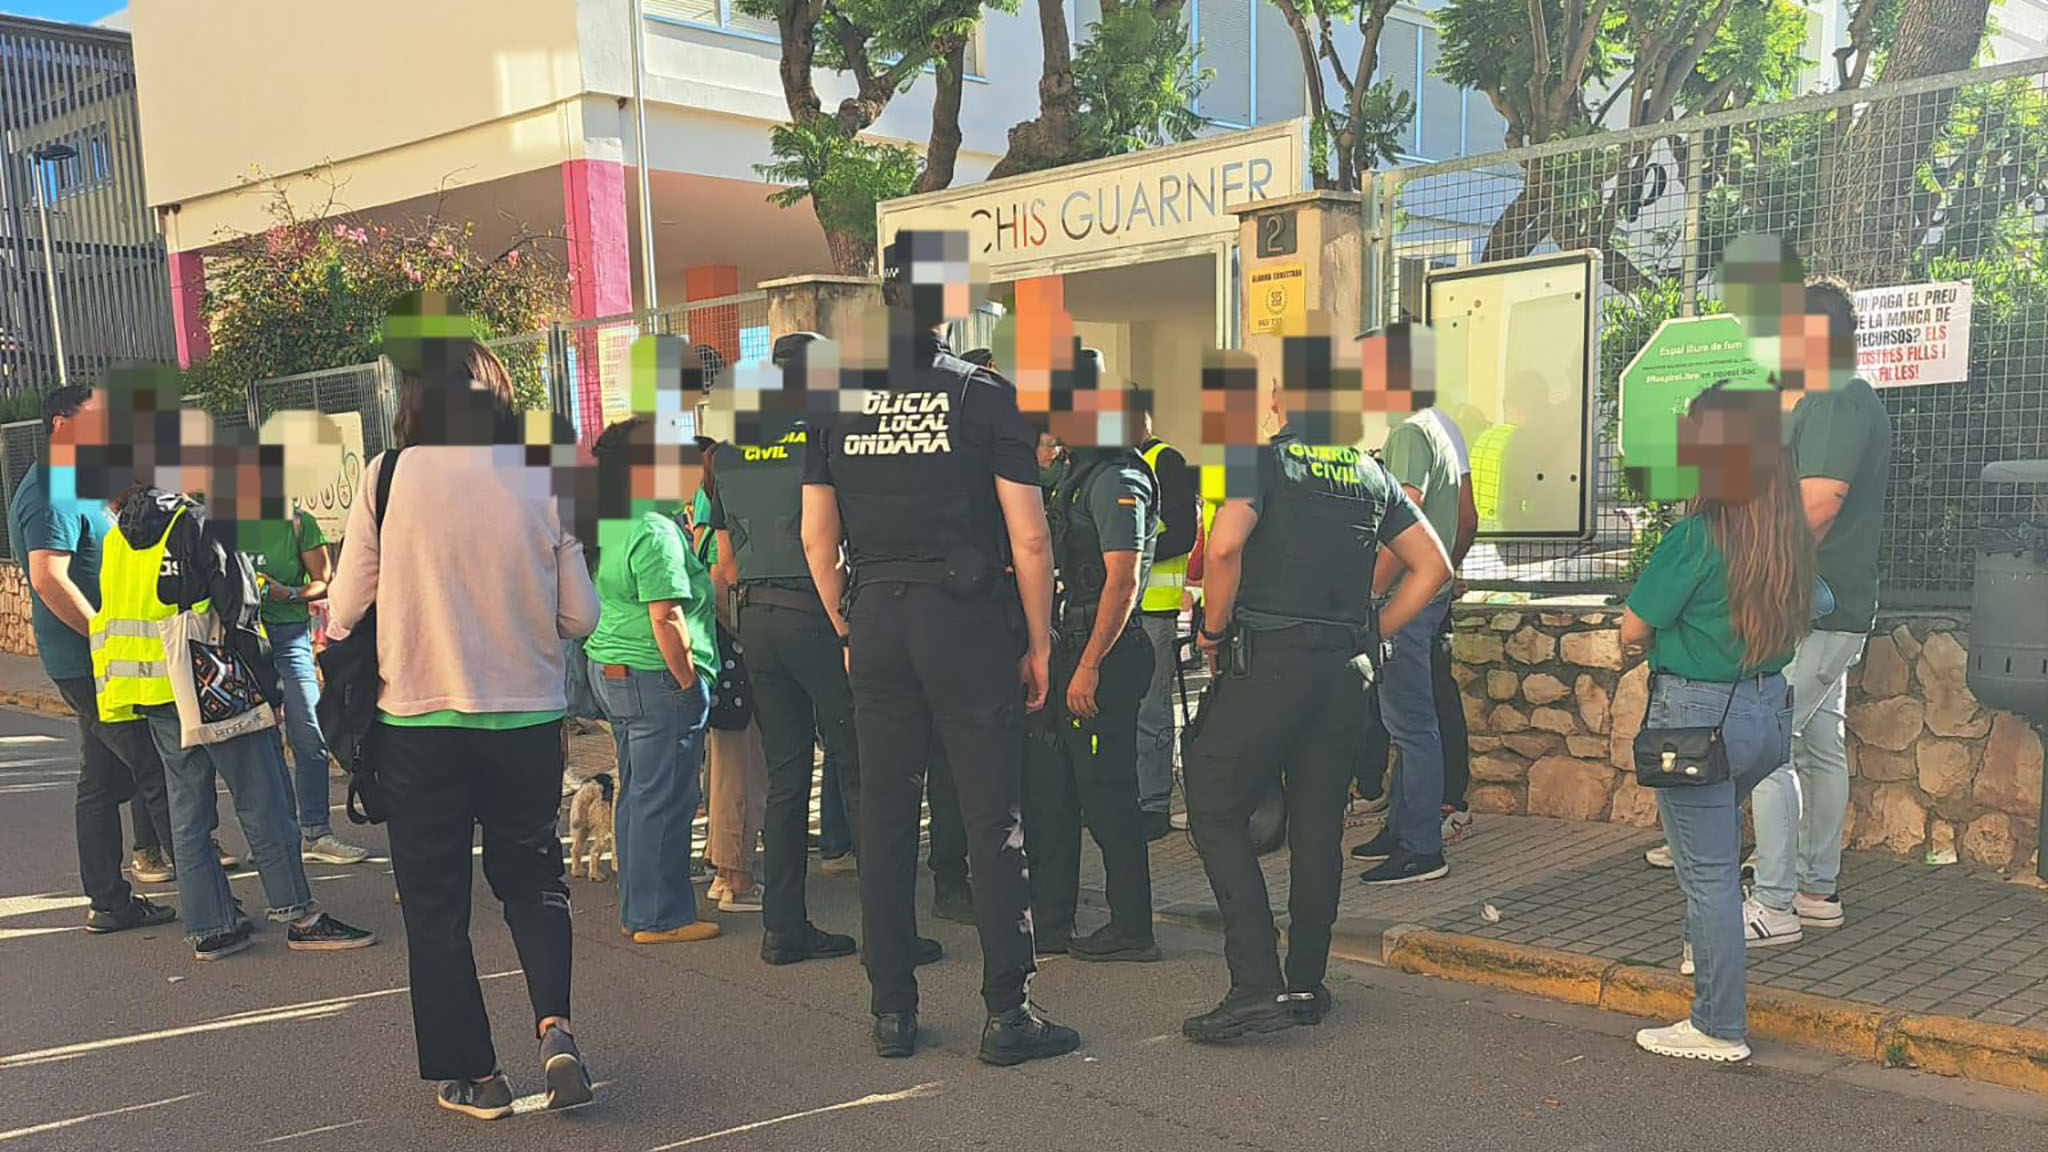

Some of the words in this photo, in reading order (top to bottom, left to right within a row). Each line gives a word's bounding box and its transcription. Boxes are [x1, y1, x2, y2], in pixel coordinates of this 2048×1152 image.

[1061, 158, 1273, 241] GUARNER
[1266, 216, 1284, 252] 2
[1871, 293, 1903, 311] PAGA
[1907, 291, 1920, 307] EL
[1925, 288, 1957, 306] PREU
[1869, 313, 1882, 329] LA
[1887, 309, 1931, 327] MANCA
[1935, 306, 1952, 322] DE
[1925, 325, 1947, 341] ELS
[1711, 342, 1722, 351] de
[1724, 341, 1743, 350] fum
[1907, 344, 1938, 361] FILLS
[863, 391, 950, 414] OLICIA
[878, 414, 949, 433] LOCAL
[744, 445, 789, 460] CIVIL
[844, 432, 951, 455] ONDARA
[1311, 462, 1361, 483] CIVIL
